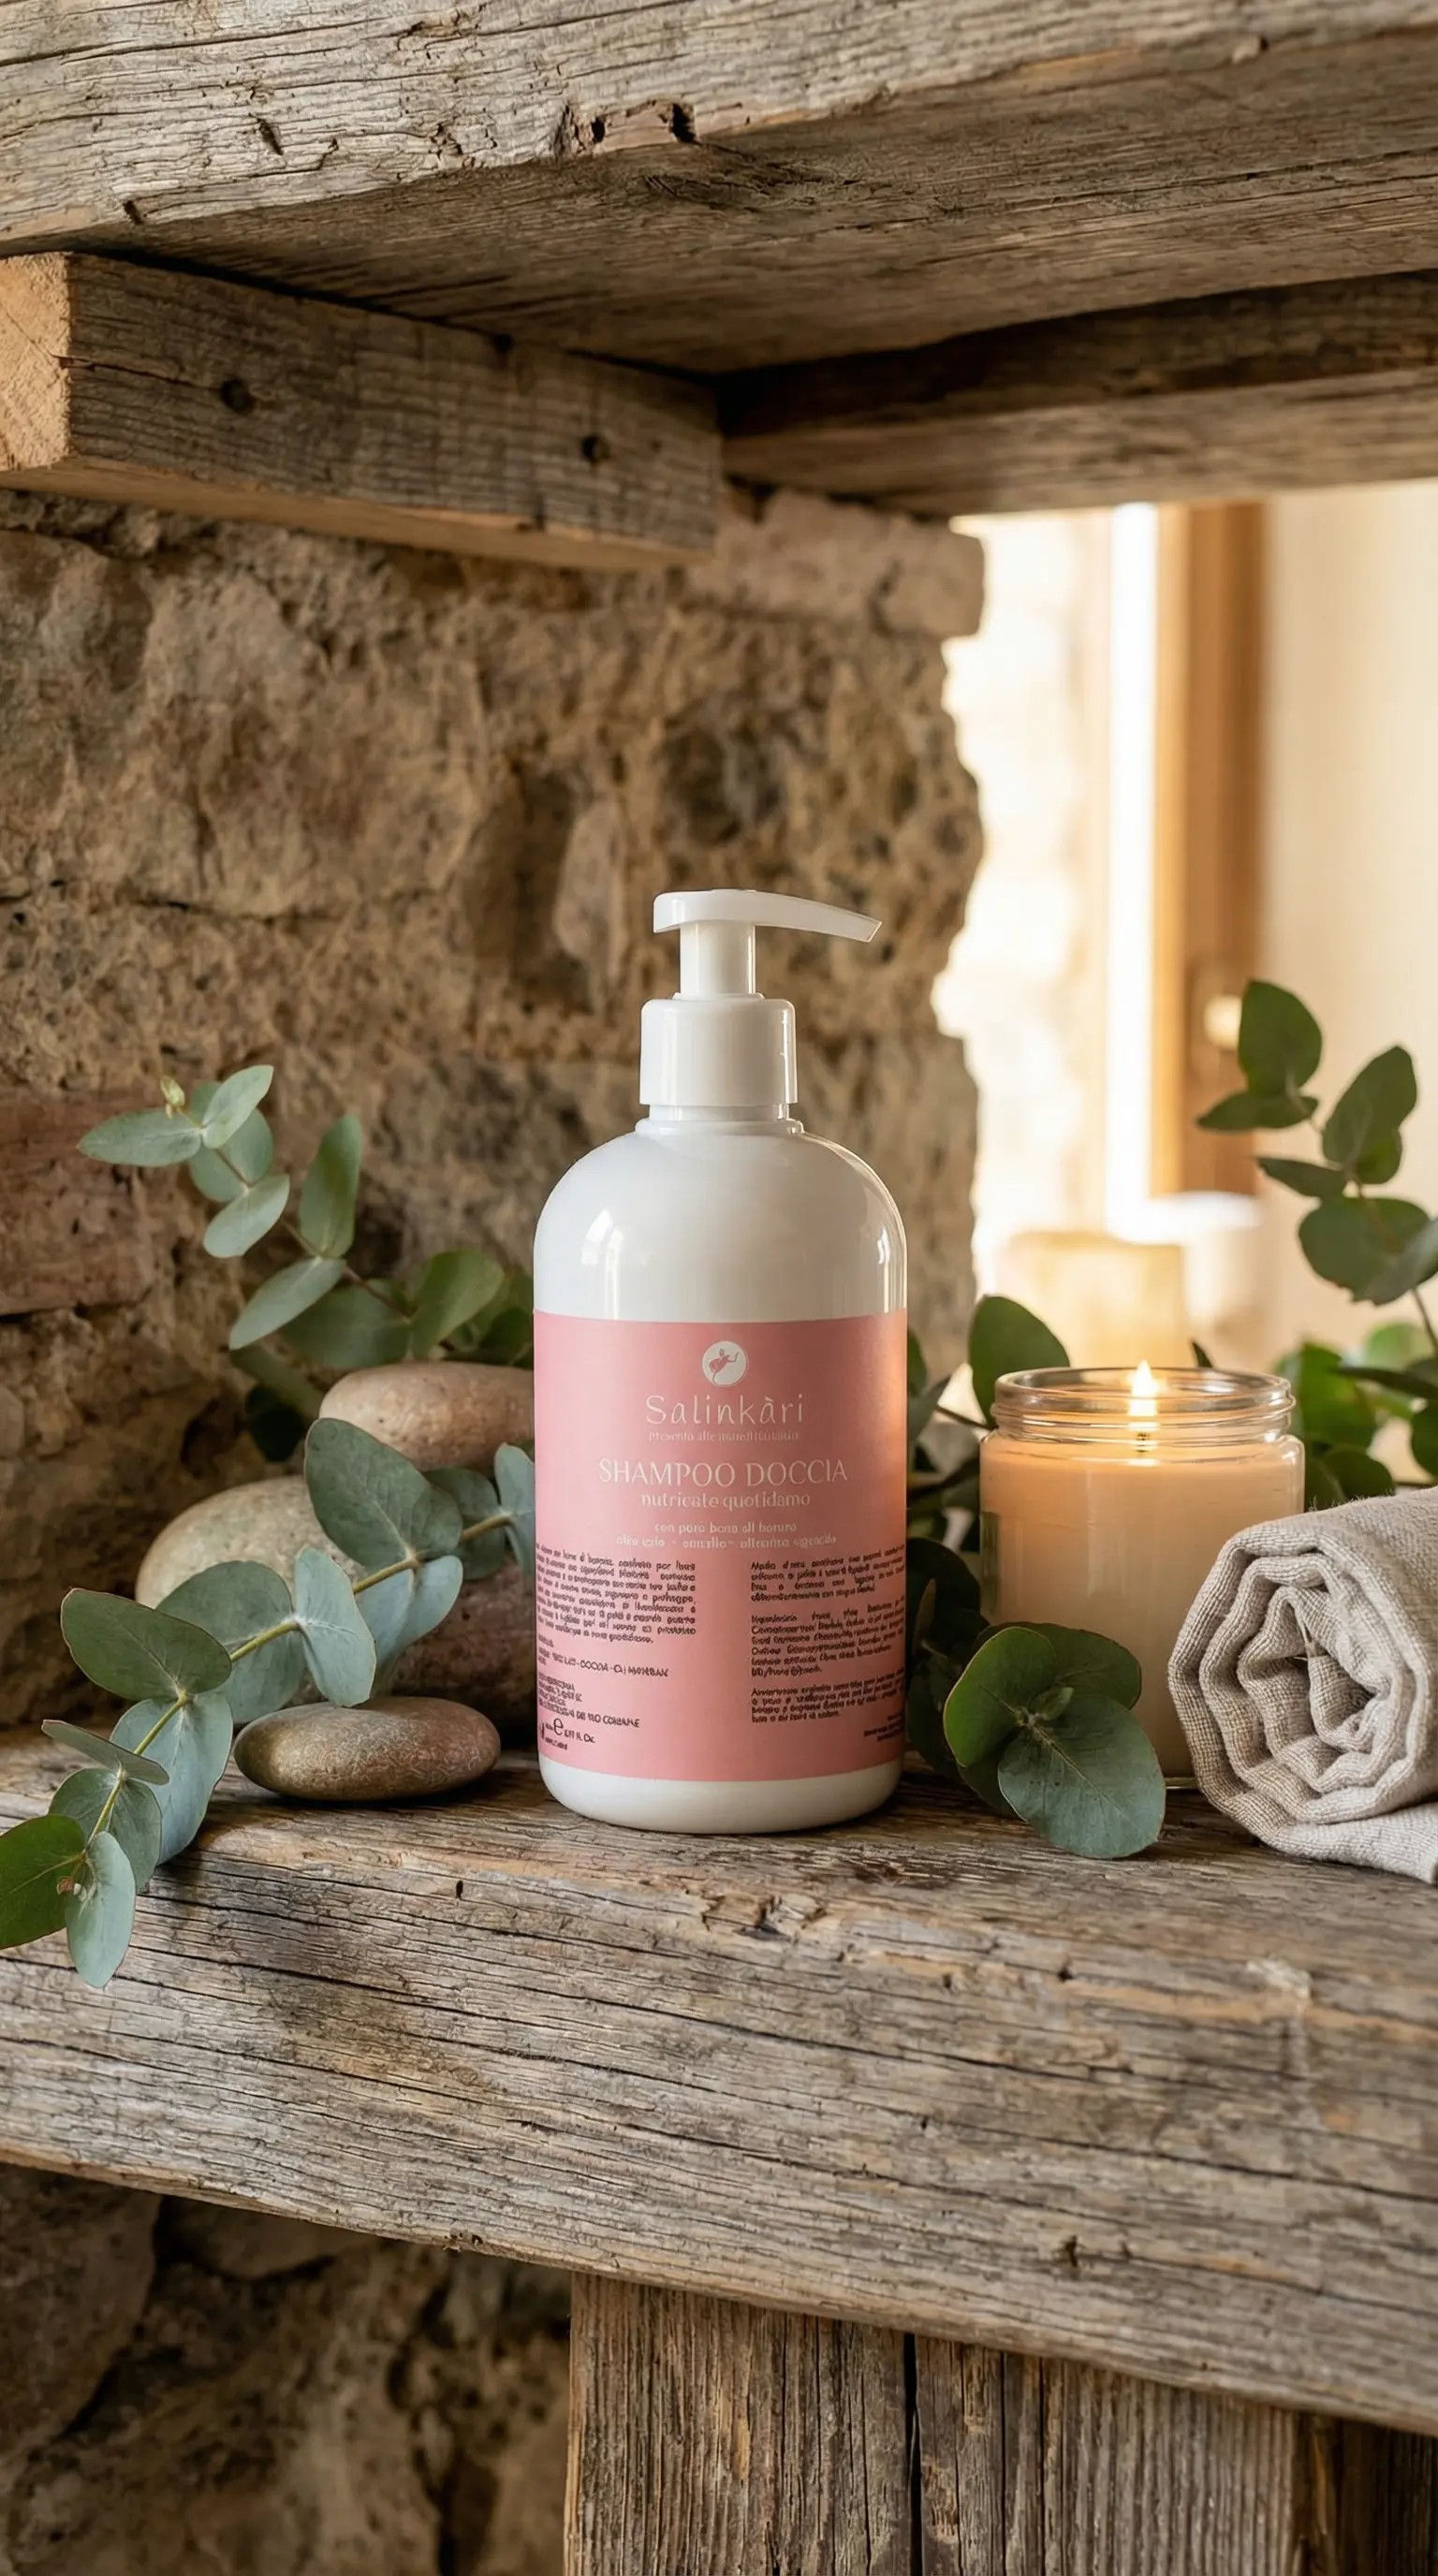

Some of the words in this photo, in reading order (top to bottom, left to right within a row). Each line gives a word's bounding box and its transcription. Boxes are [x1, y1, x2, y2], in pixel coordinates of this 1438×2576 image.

[645, 1394, 803, 1425] Salinkàri
[599, 1457, 736, 1487] SHAMPOO
[746, 1459, 848, 1487] DOCCIA
